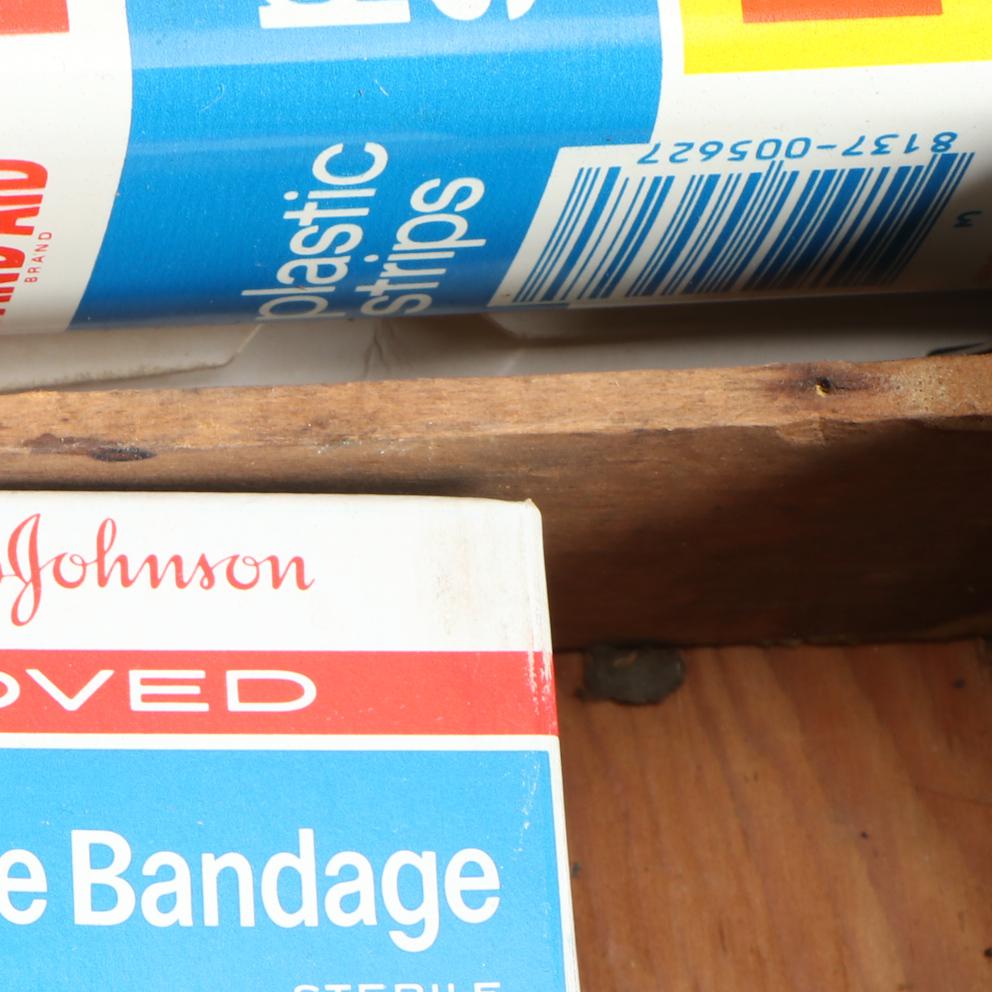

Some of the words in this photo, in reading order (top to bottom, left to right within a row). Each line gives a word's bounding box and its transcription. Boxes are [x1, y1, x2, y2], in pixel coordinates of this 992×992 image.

[637, 130, 958, 165] 8137-005627
[25, 231, 53, 284] BRAND
[242, 142, 389, 320] plastic
[356, 177, 487, 317] strips
[7, 512, 316, 626] Johnson
[71, 827, 502, 953] Bandage
